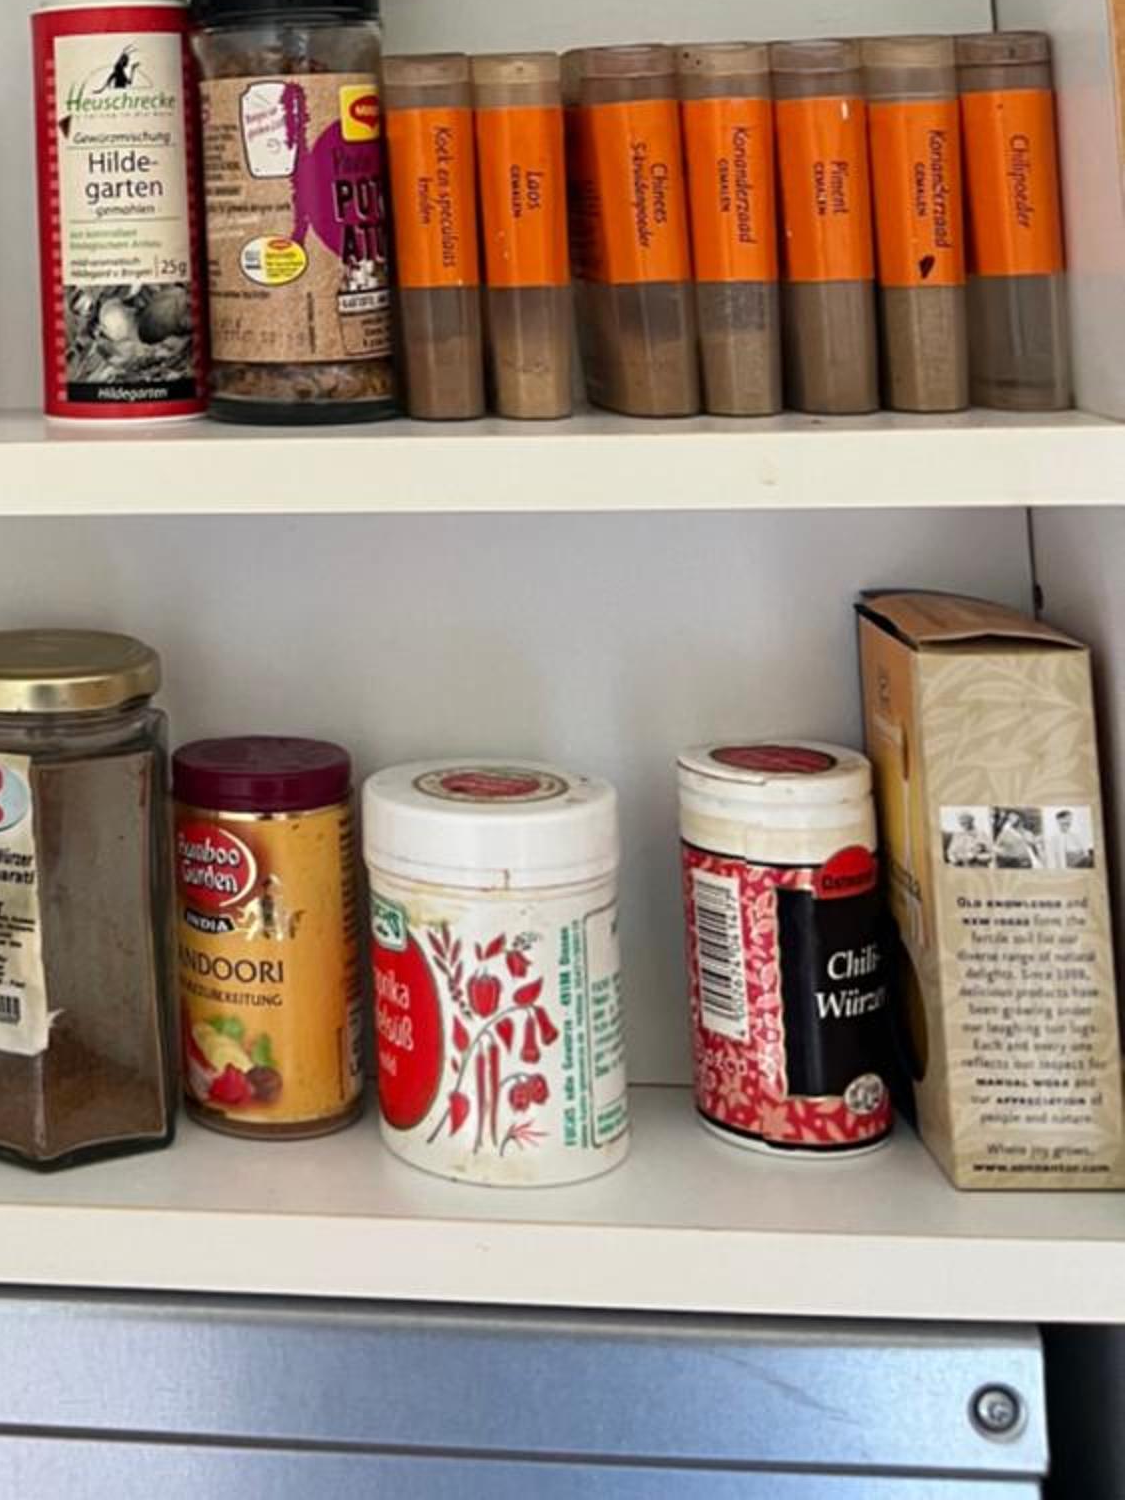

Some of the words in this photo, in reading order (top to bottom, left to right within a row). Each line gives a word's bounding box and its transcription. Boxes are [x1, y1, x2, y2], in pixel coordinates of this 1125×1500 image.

[66, 82, 177, 113] Heuschrecke
[72, 131, 171, 146] Gewürzmischung
[433, 125, 454, 164] Koek
[88, 151, 158, 174] Hilde-
[437, 169, 449, 187] en
[85, 179, 163, 205] garten
[525, 170, 545, 211] Laos
[649, 162, 668, 225] Chinees
[733, 126, 757, 245] Korianderzaad
[830, 160, 849, 215] Piment
[928, 129, 953, 249] Korianderzaad
[1007, 133, 1035, 229] Chilipoeder
[95, 204, 155, 218] gemahlen
[97, 387, 169, 402] Hildegarten
